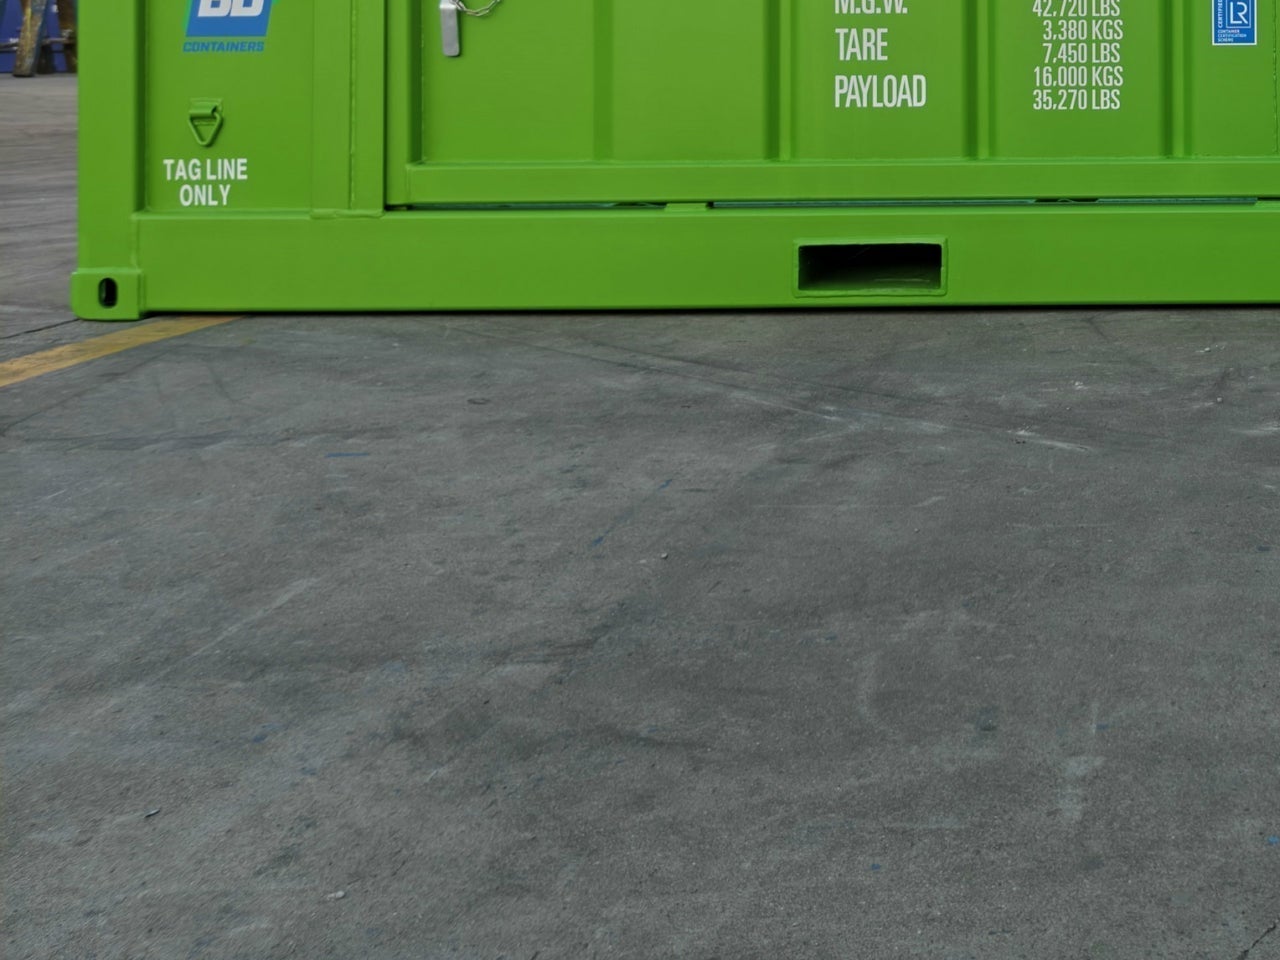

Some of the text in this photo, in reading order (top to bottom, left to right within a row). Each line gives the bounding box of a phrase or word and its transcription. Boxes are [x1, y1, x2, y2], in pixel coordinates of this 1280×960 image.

[1229, 1, 1249, 24] LR
[1042, 18, 1124, 41] 3,380 KGS
[183, 41, 265, 53] CONTAINERS
[834, 27, 888, 61] TARE
[1042, 42, 1121, 64] 7,450 LBS
[1033, 65, 1124, 88] 16,000 KGS
[834, 74, 927, 108] PAYLOAD
[1032, 88, 1121, 110] 35,270 LBS
[163, 158, 248, 181] TAG LINE
[179, 184, 231, 207] ONLY
